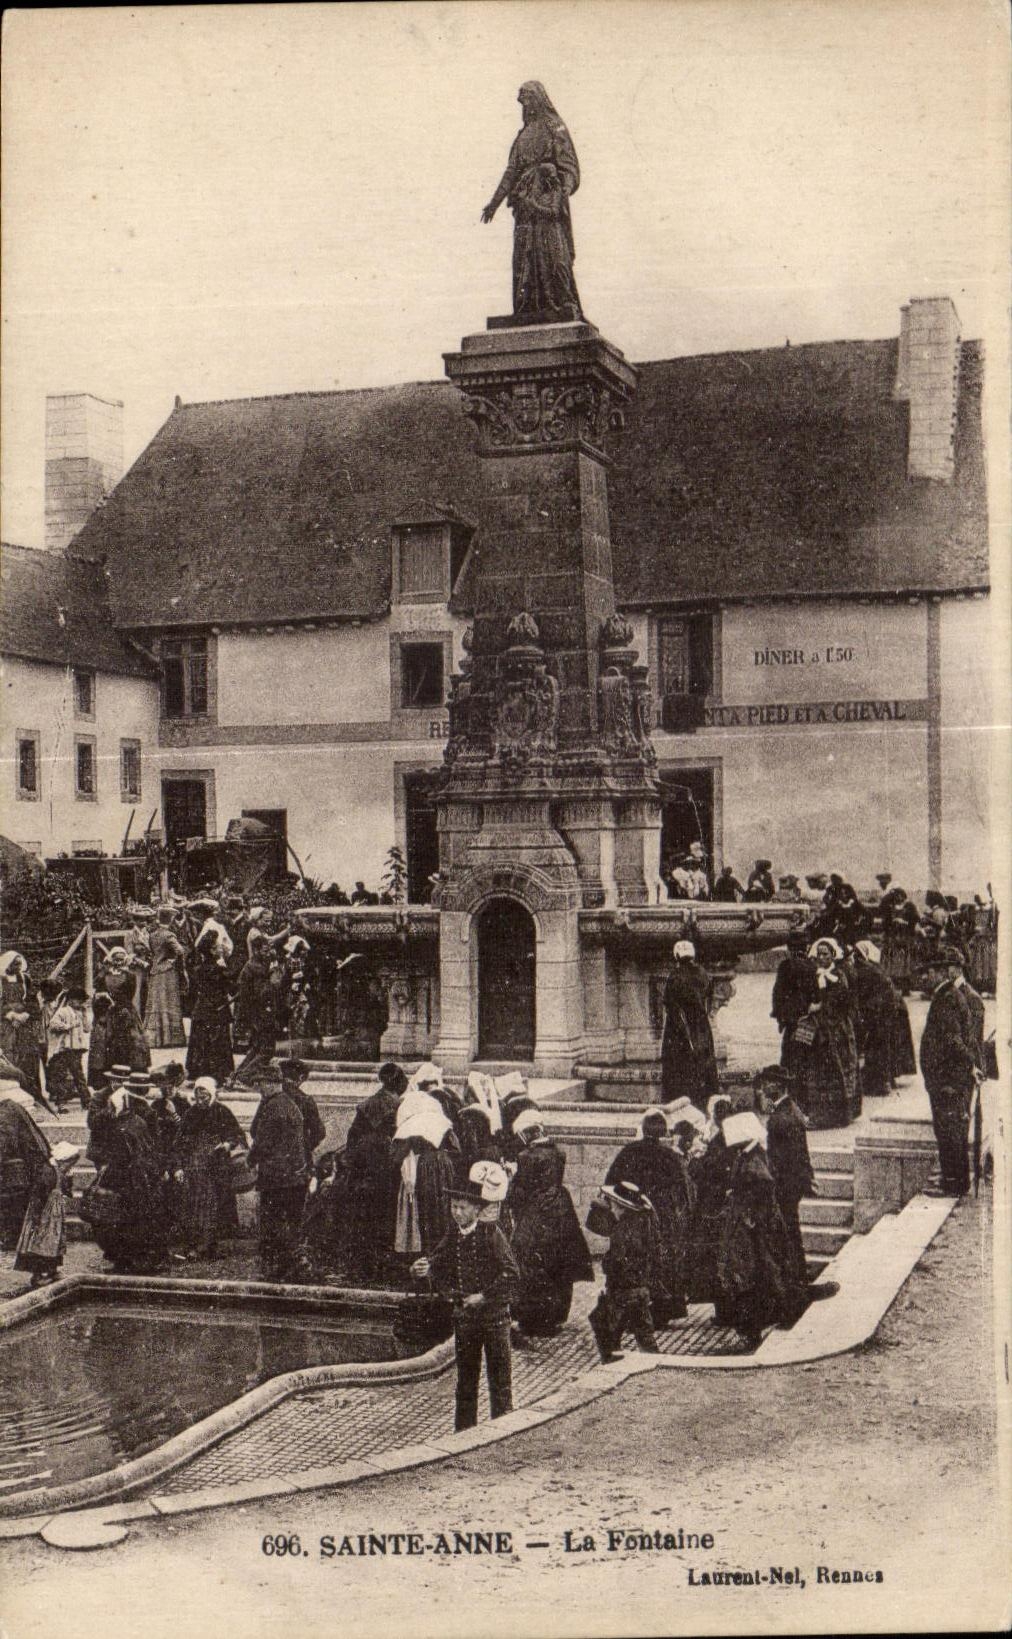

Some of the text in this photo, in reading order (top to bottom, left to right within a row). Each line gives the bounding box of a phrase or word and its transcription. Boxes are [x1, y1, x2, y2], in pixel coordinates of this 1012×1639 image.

[747, 704, 790, 725] PIED
[794, 706, 811, 724] ET
[832, 701, 906, 721] CHEVAL
